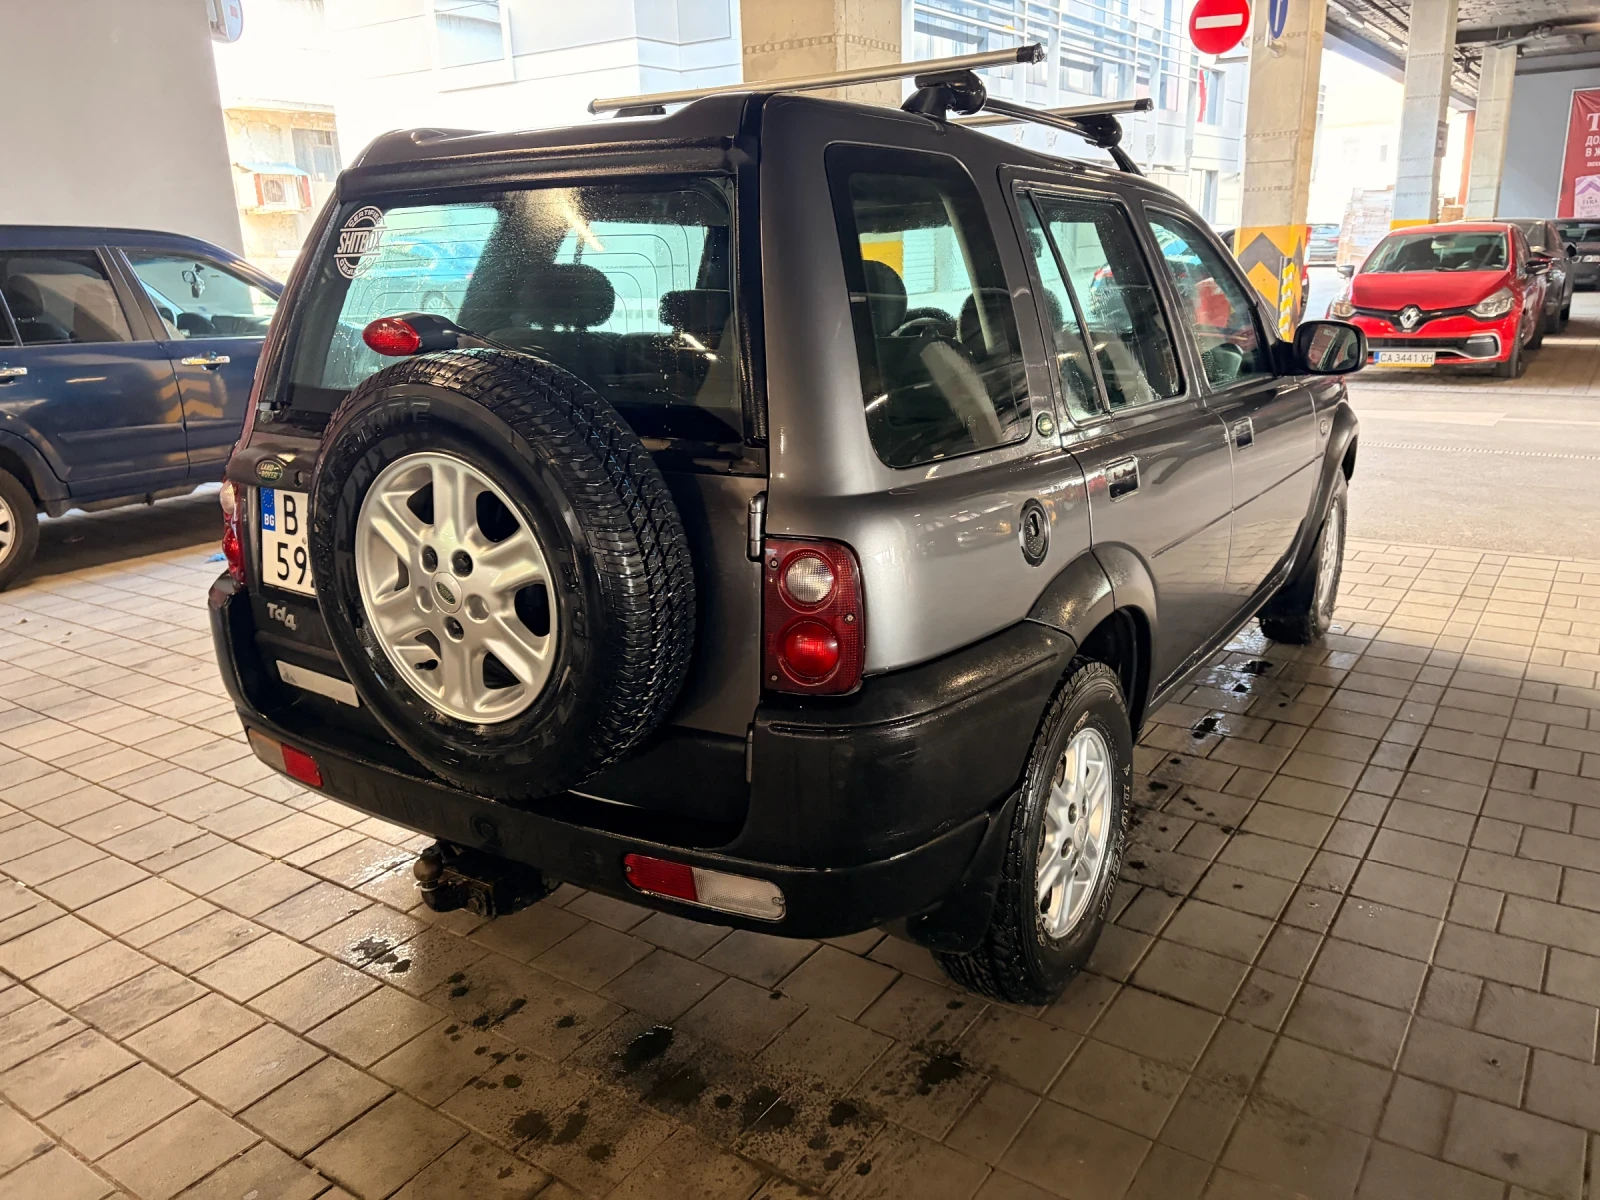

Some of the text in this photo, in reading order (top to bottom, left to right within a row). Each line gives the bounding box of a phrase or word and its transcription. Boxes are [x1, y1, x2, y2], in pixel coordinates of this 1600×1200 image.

[1585, 135, 1600, 147] ДО
[348, 209, 382, 227] CERTIFIED
[337, 231, 383, 254] SHITBOX
[1381, 354, 1433, 363] CA 3441 XH
[261, 470, 278, 479] ROVER
[264, 513, 275, 526] BG
[277, 541, 315, 588] 59
[266, 602, 297, 631] Td4
